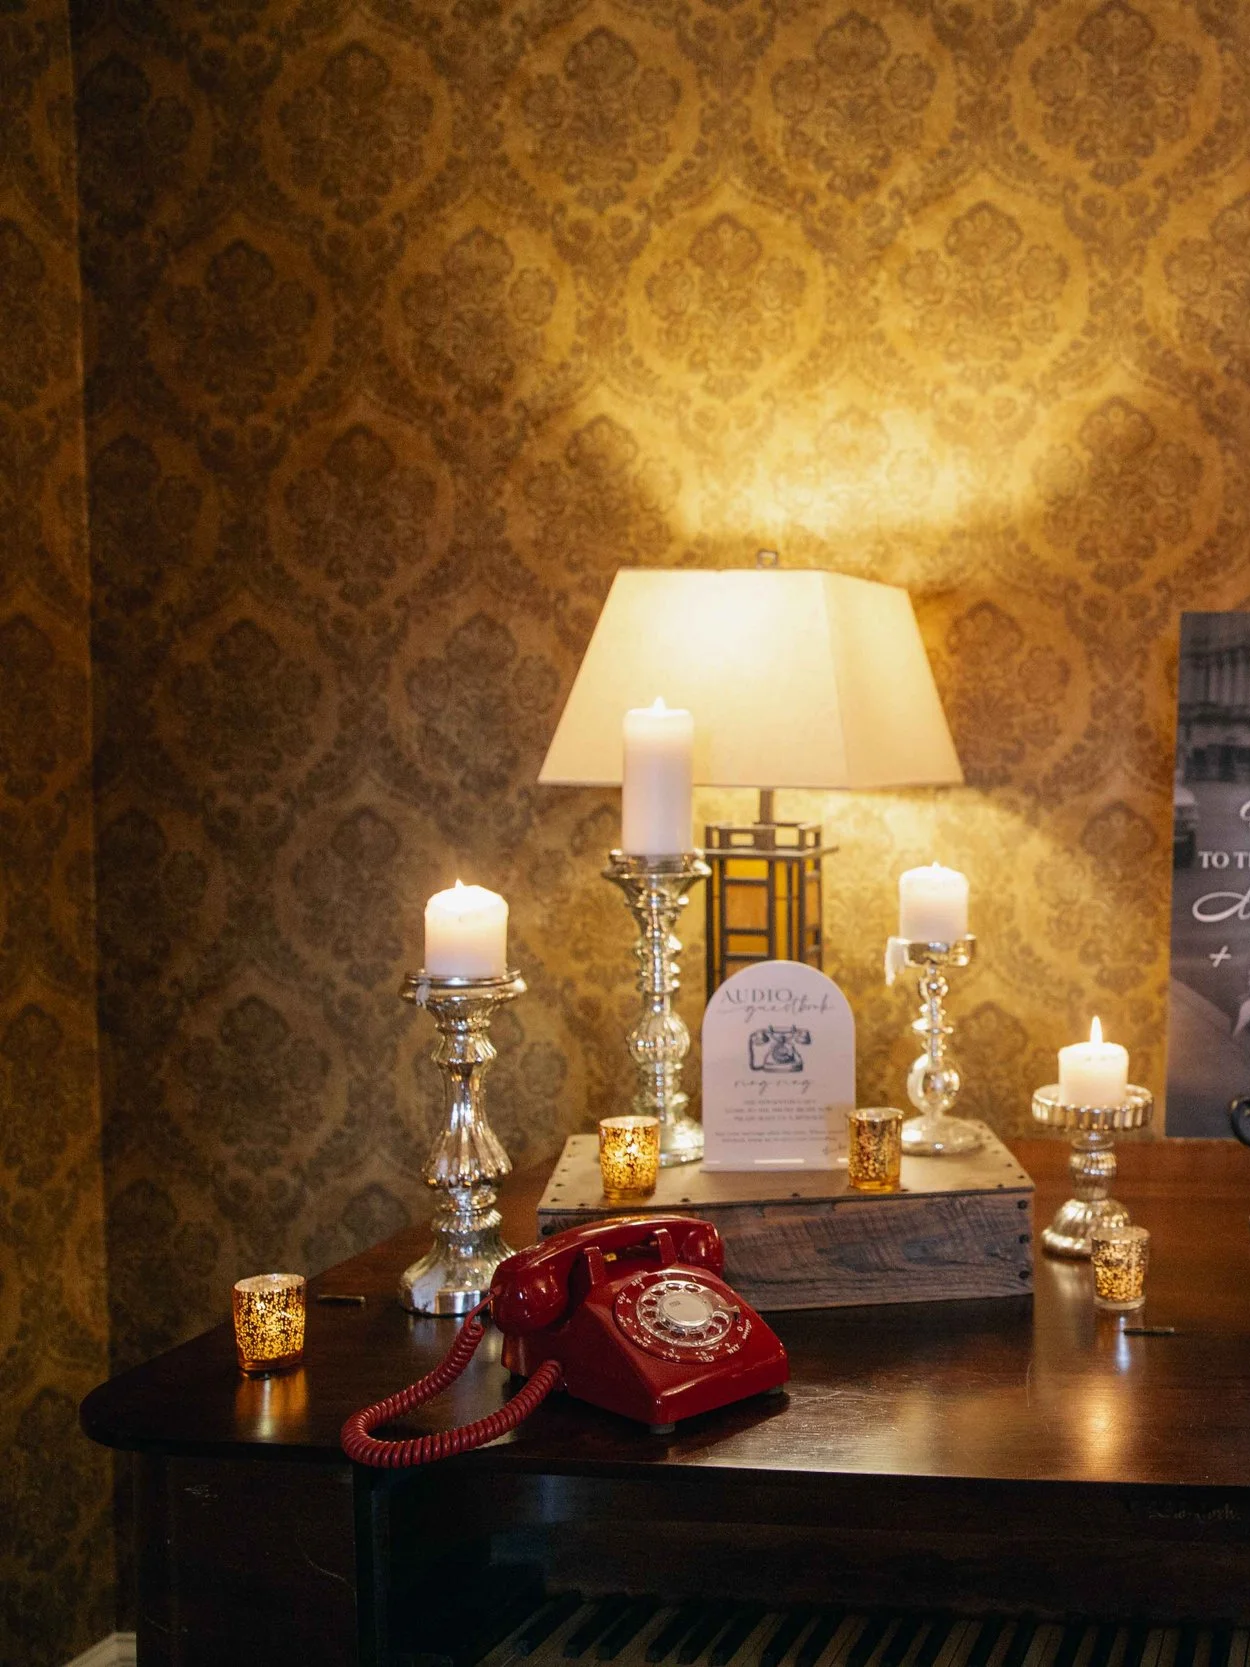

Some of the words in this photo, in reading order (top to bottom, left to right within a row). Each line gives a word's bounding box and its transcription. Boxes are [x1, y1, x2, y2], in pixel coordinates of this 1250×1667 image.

[1200, 851, 1230, 870] TO
[1208, 945, 1233, 968] +
[721, 988, 793, 1005] AUDIO
